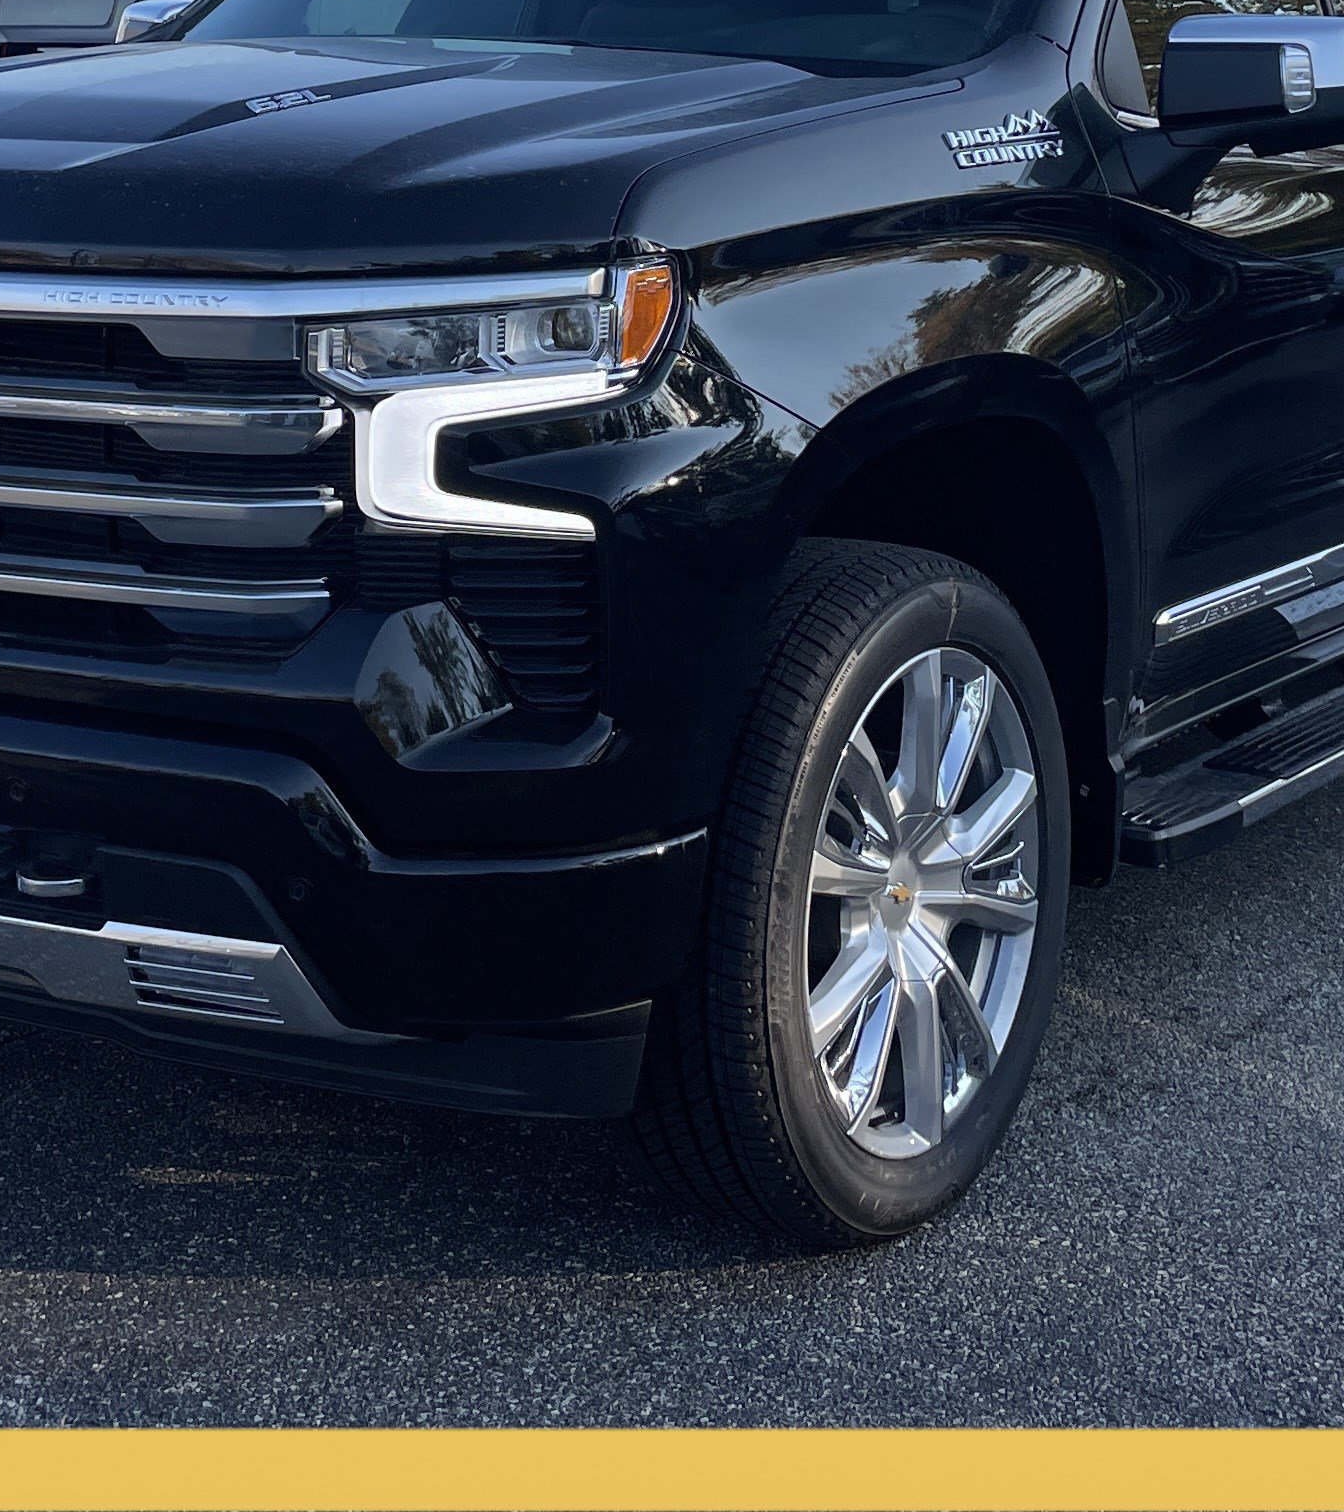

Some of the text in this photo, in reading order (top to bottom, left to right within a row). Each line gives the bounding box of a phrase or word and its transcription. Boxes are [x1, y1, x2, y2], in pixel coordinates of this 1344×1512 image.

[944, 124, 1007, 150] HIGH
[955, 139, 1064, 169] COUNTRY
[110, 292, 229, 307] COUNTRY
